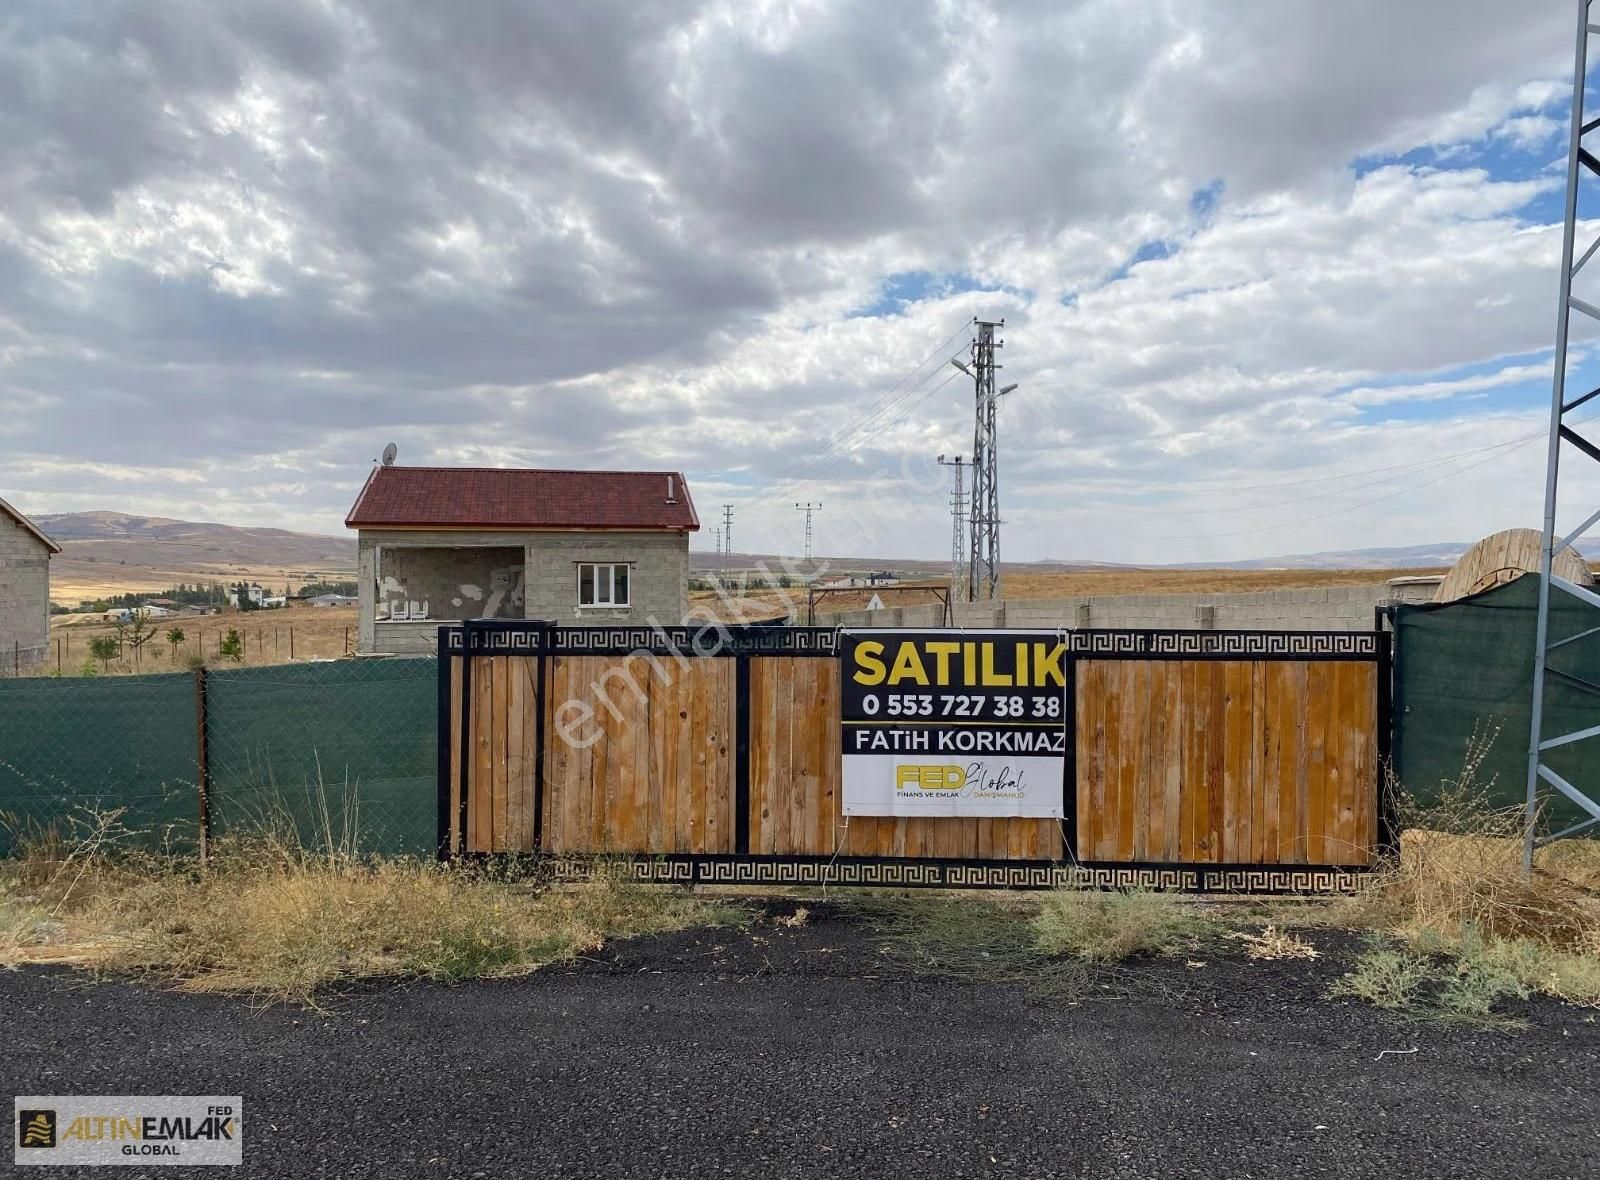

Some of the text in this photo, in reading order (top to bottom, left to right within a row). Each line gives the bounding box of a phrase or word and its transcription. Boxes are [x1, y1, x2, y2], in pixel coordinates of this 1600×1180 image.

[853, 641, 1066, 687] SATILIK
[862, 694, 1060, 718] 0 553 727 38 38
[938, 731, 1065, 752] KORKMAZ
[896, 765, 966, 790] FED
